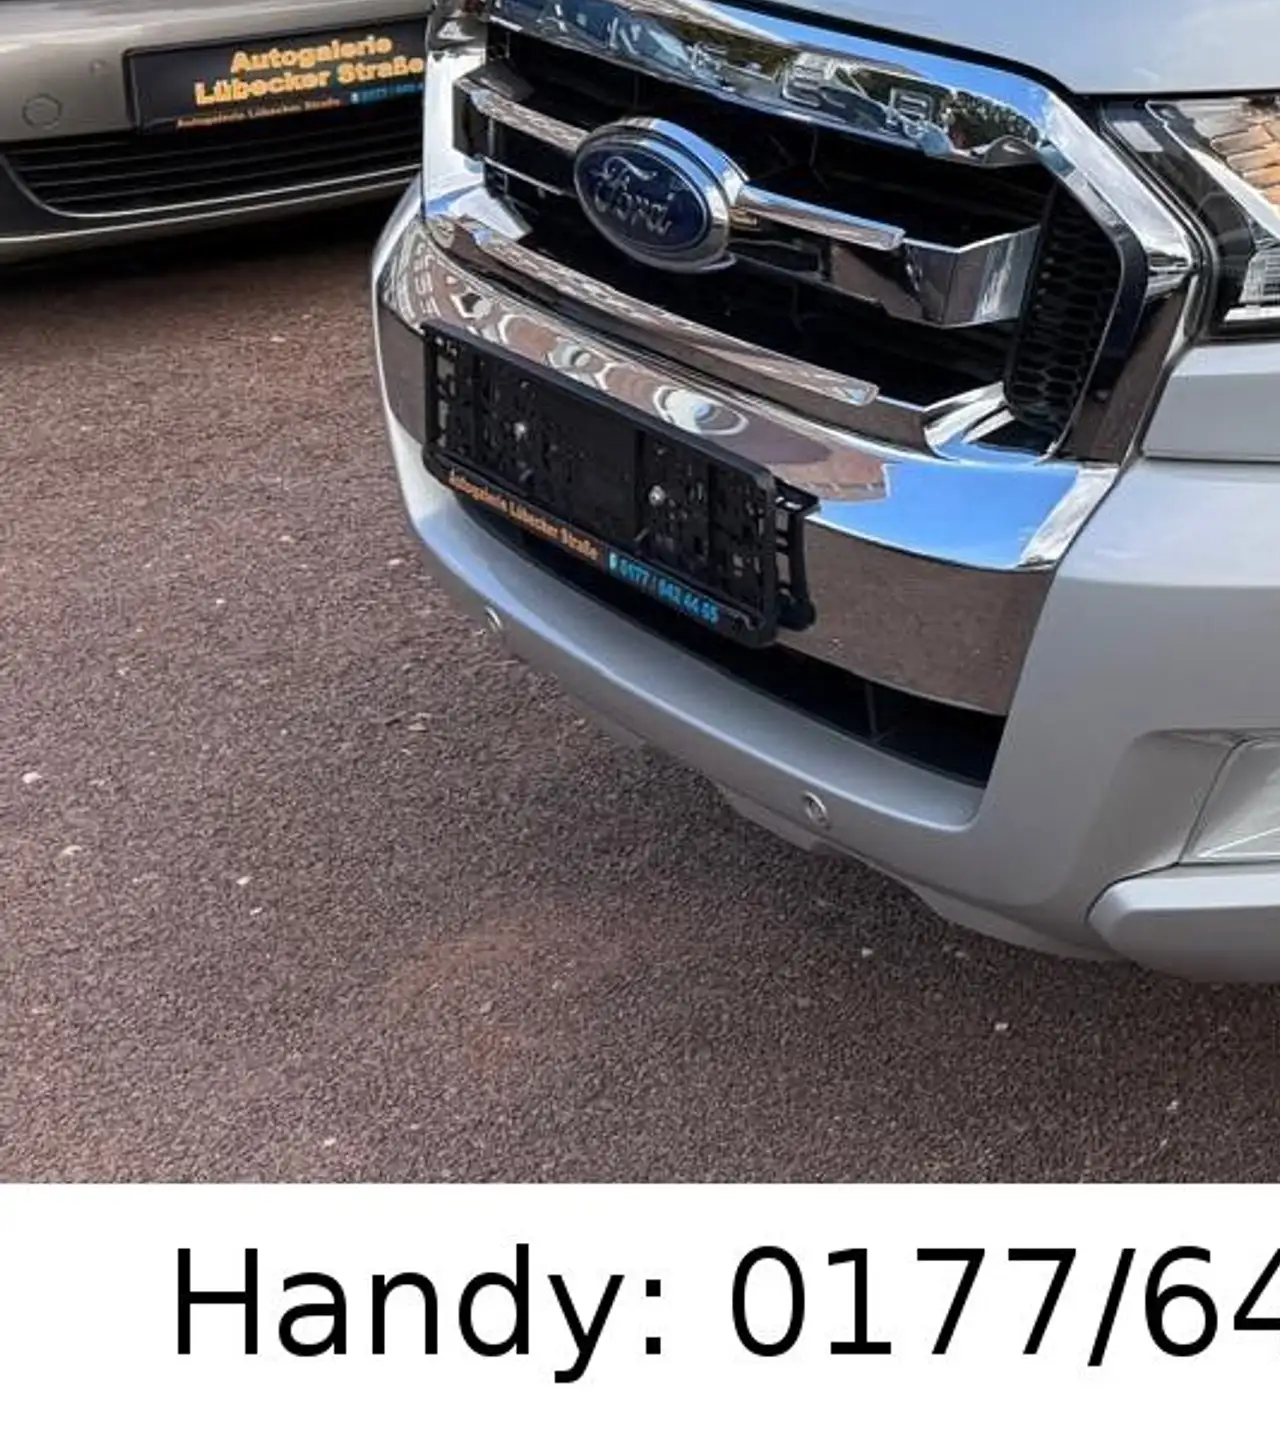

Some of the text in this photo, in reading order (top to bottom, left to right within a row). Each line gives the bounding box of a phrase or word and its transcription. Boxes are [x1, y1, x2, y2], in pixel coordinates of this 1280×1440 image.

[230, 35, 392, 73] Autogalerie
[194, 70, 331, 105] Lübecker
[336, 55, 425, 83] Straße
[589, 156, 675, 236] Ford
